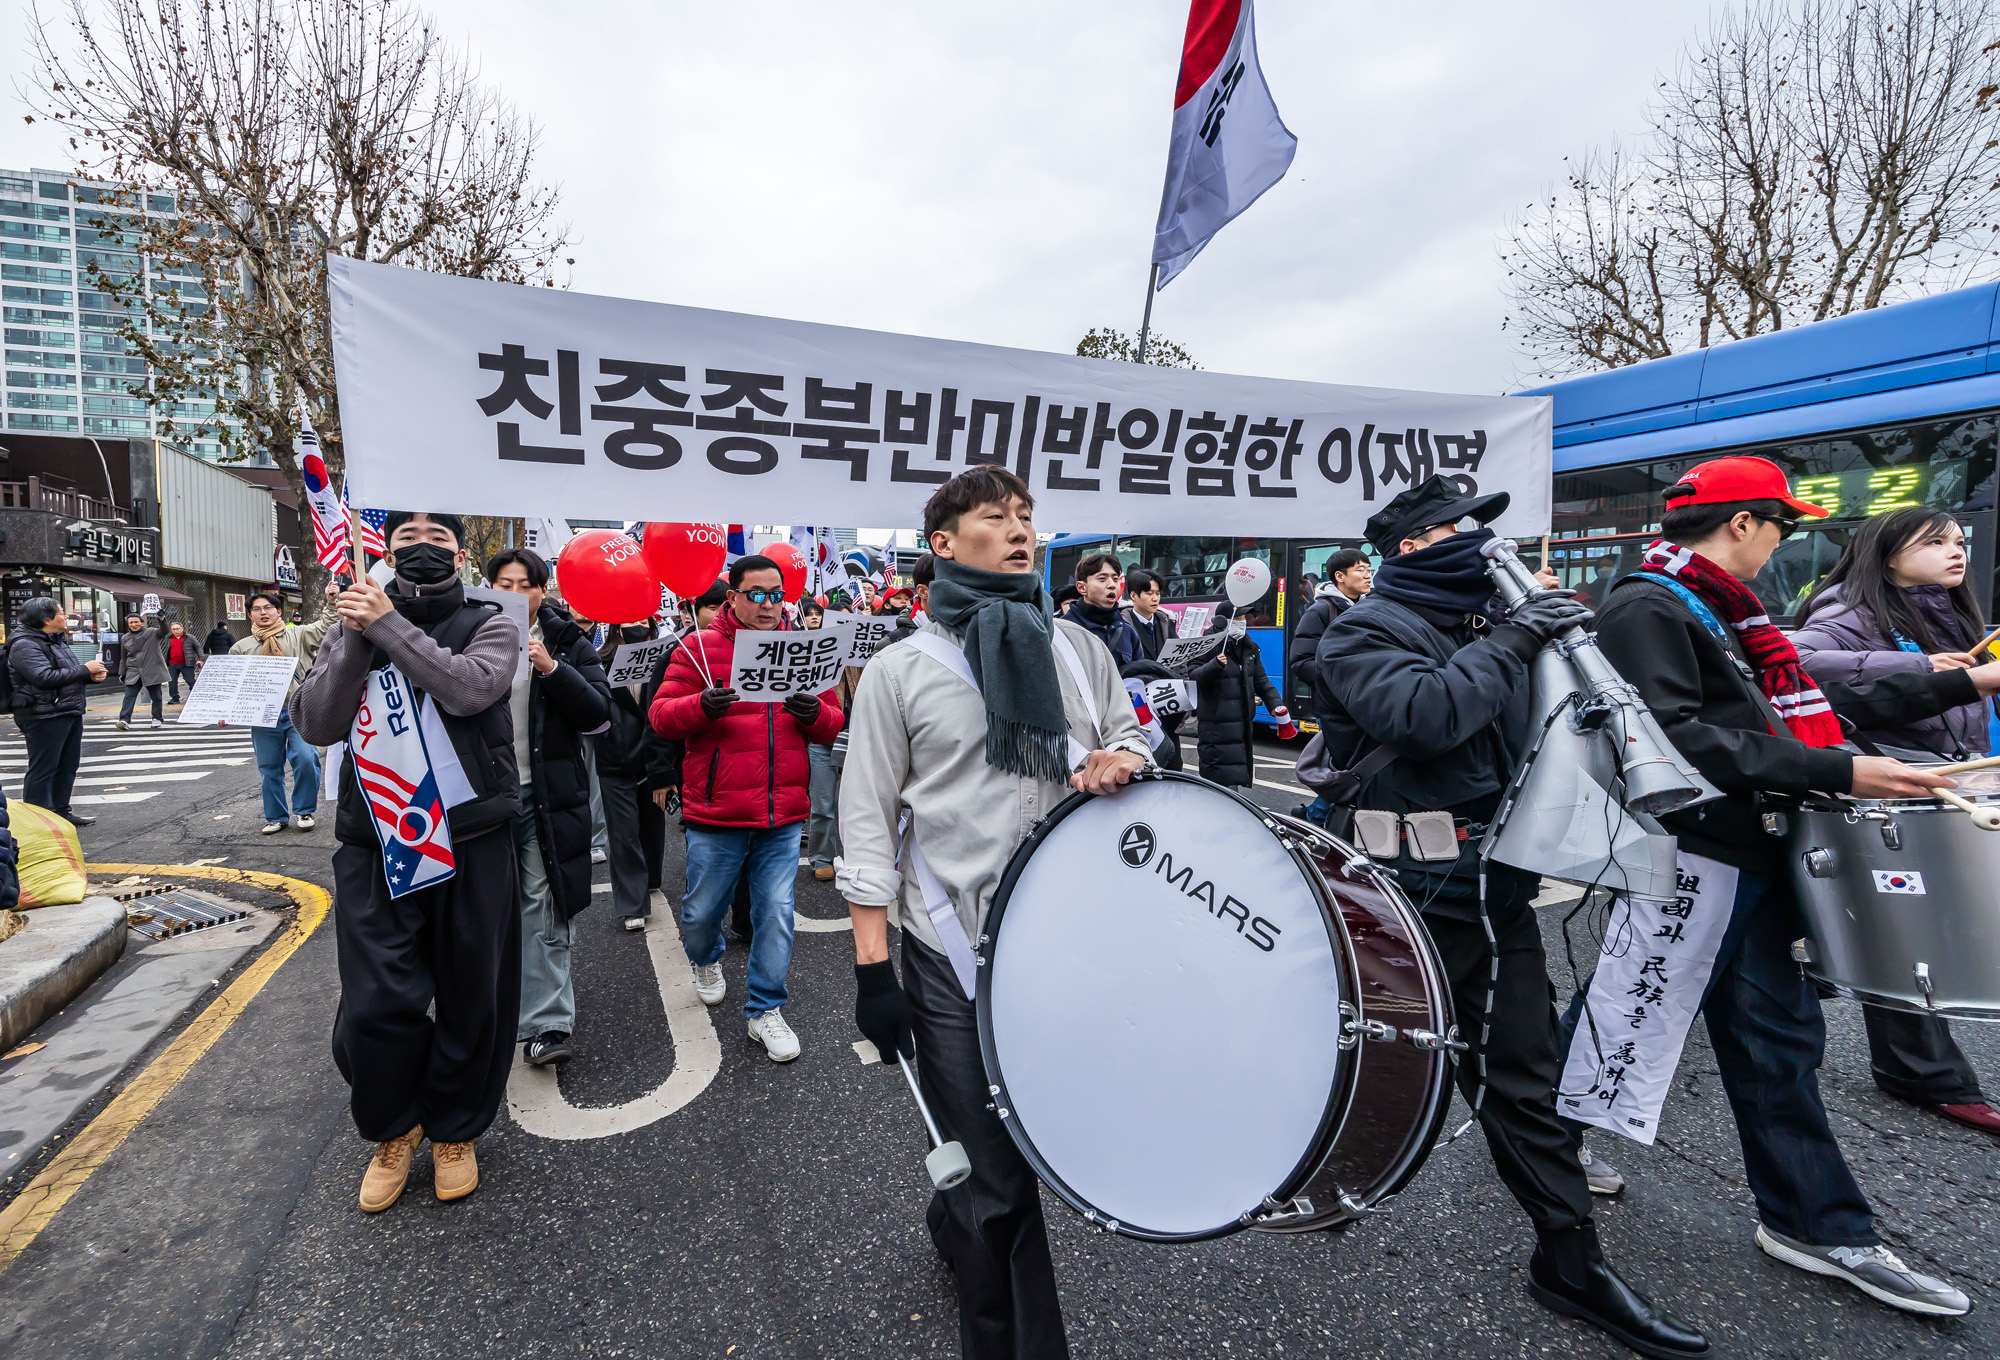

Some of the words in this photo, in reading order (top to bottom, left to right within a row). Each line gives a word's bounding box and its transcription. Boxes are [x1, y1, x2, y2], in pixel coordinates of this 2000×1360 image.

[476, 343, 1304, 498] 친중종북반미반일혐한
[1318, 424, 1487, 501] 이재명
[600, 536, 630, 554] FREE
[685, 529, 725, 548] YOON
[604, 544, 643, 567] YOON
[755, 636, 838, 667] 계엄은
[738, 657, 843, 692] 정당했다
[1155, 853, 1281, 952] MARS
[1624, 956, 1668, 1028] 民族을
